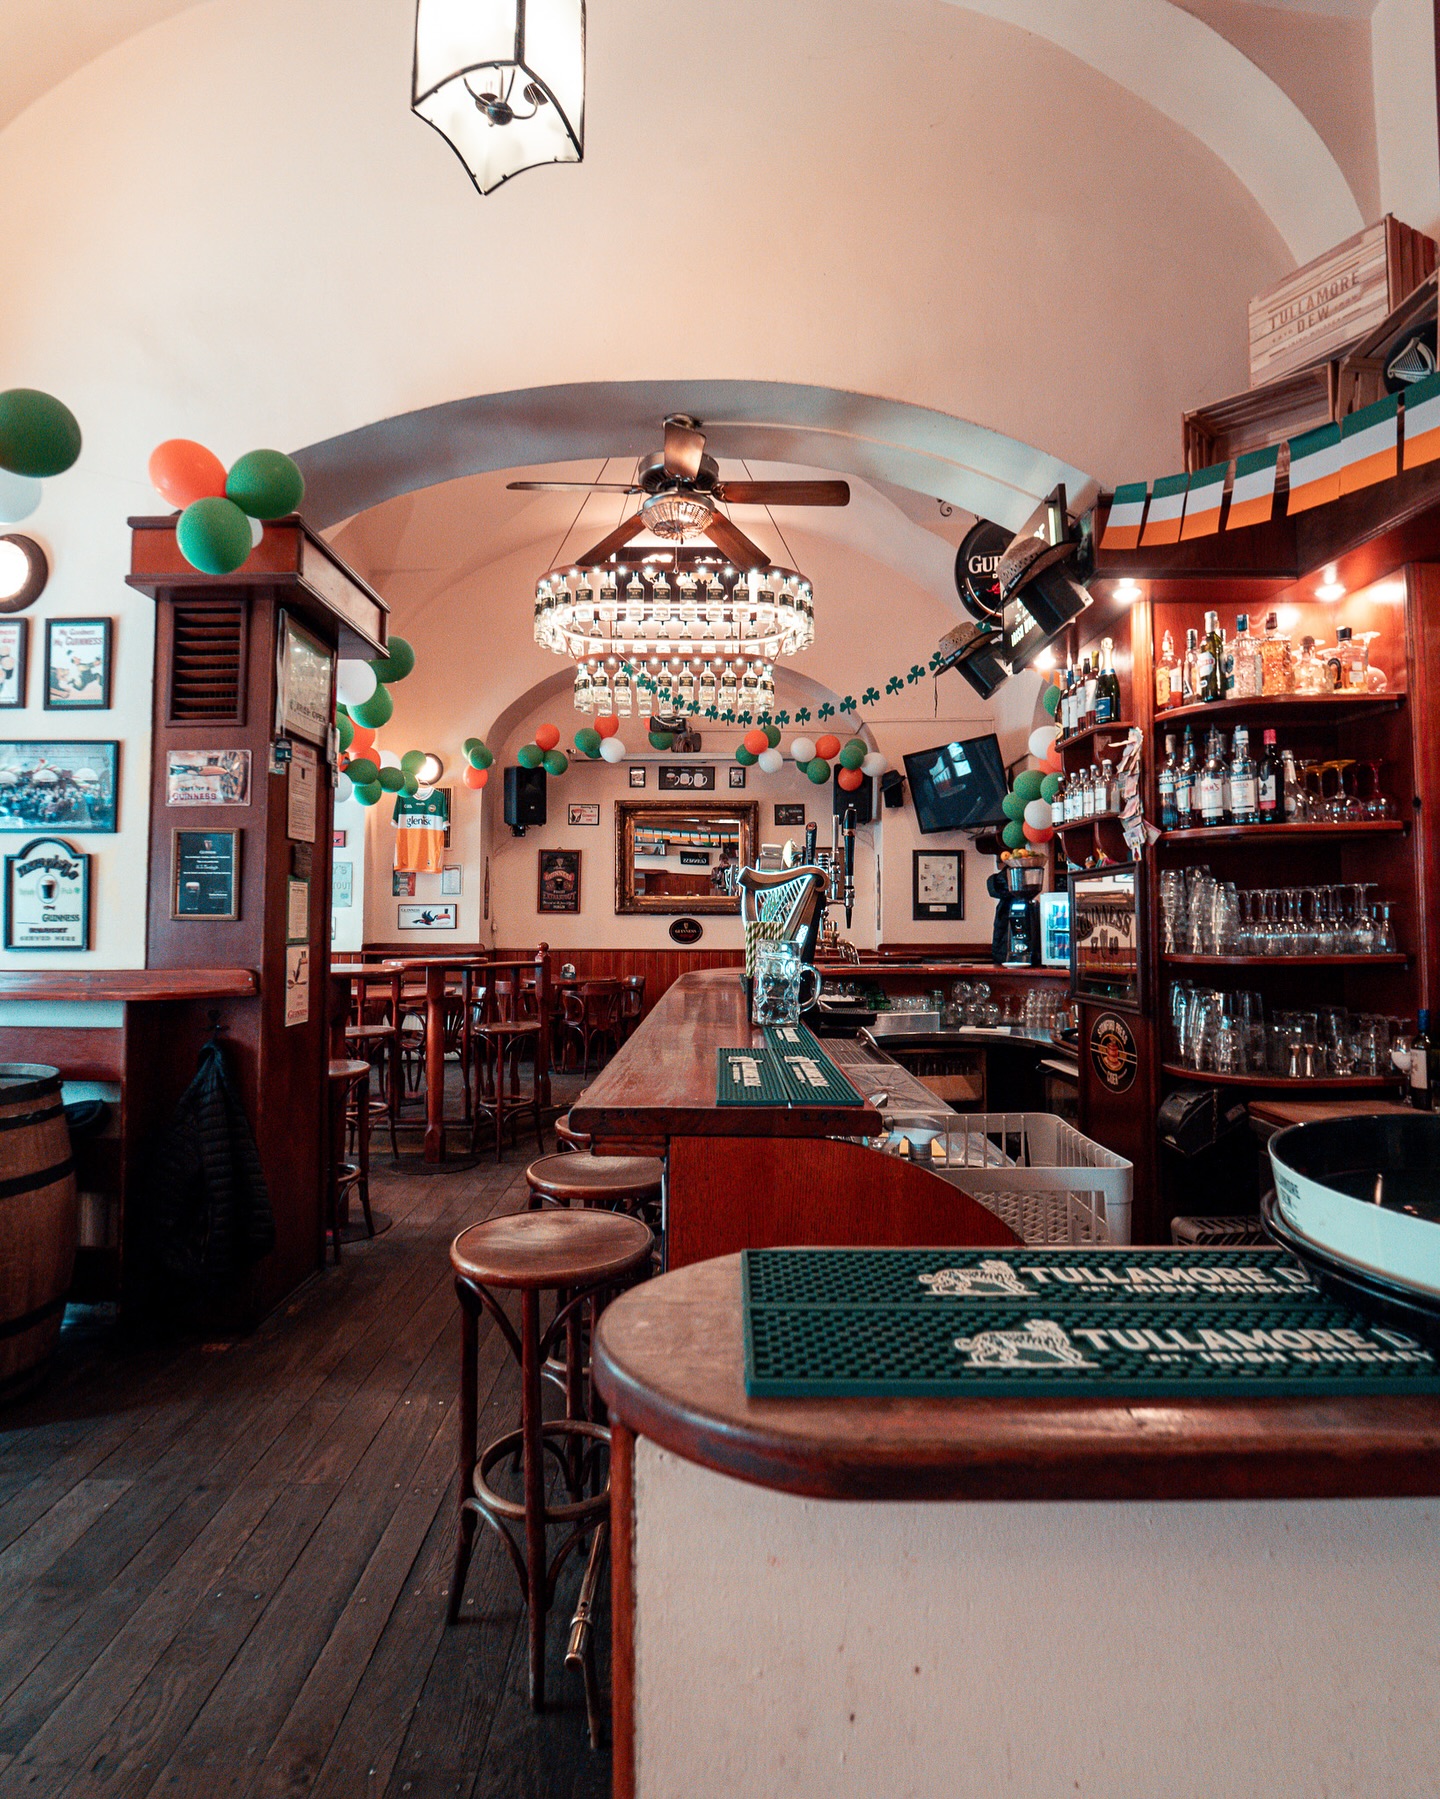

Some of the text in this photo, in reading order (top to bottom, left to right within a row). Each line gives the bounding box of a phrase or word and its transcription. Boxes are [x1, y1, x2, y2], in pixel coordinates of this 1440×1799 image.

[1268, 269, 1361, 330] TULLAMORE
[1297, 305, 1330, 334] DEW
[968, 555, 1003, 575] GUI
[65, 637, 103, 646] GUINNESS
[172, 792, 217, 801] GUINNESS
[42, 913, 81, 922] GUINNESS
[1020, 1267, 1277, 1284] TULLAMORE
[1124, 1285, 1199, 1293] IRISH
[1202, 1285, 1320, 1293] WHISKEY
[1073, 1329, 1380, 1350] TULLAMORE
[1200, 1352, 1289, 1362] IRISH
[1292, 1352, 1434, 1362] WHISKEY
